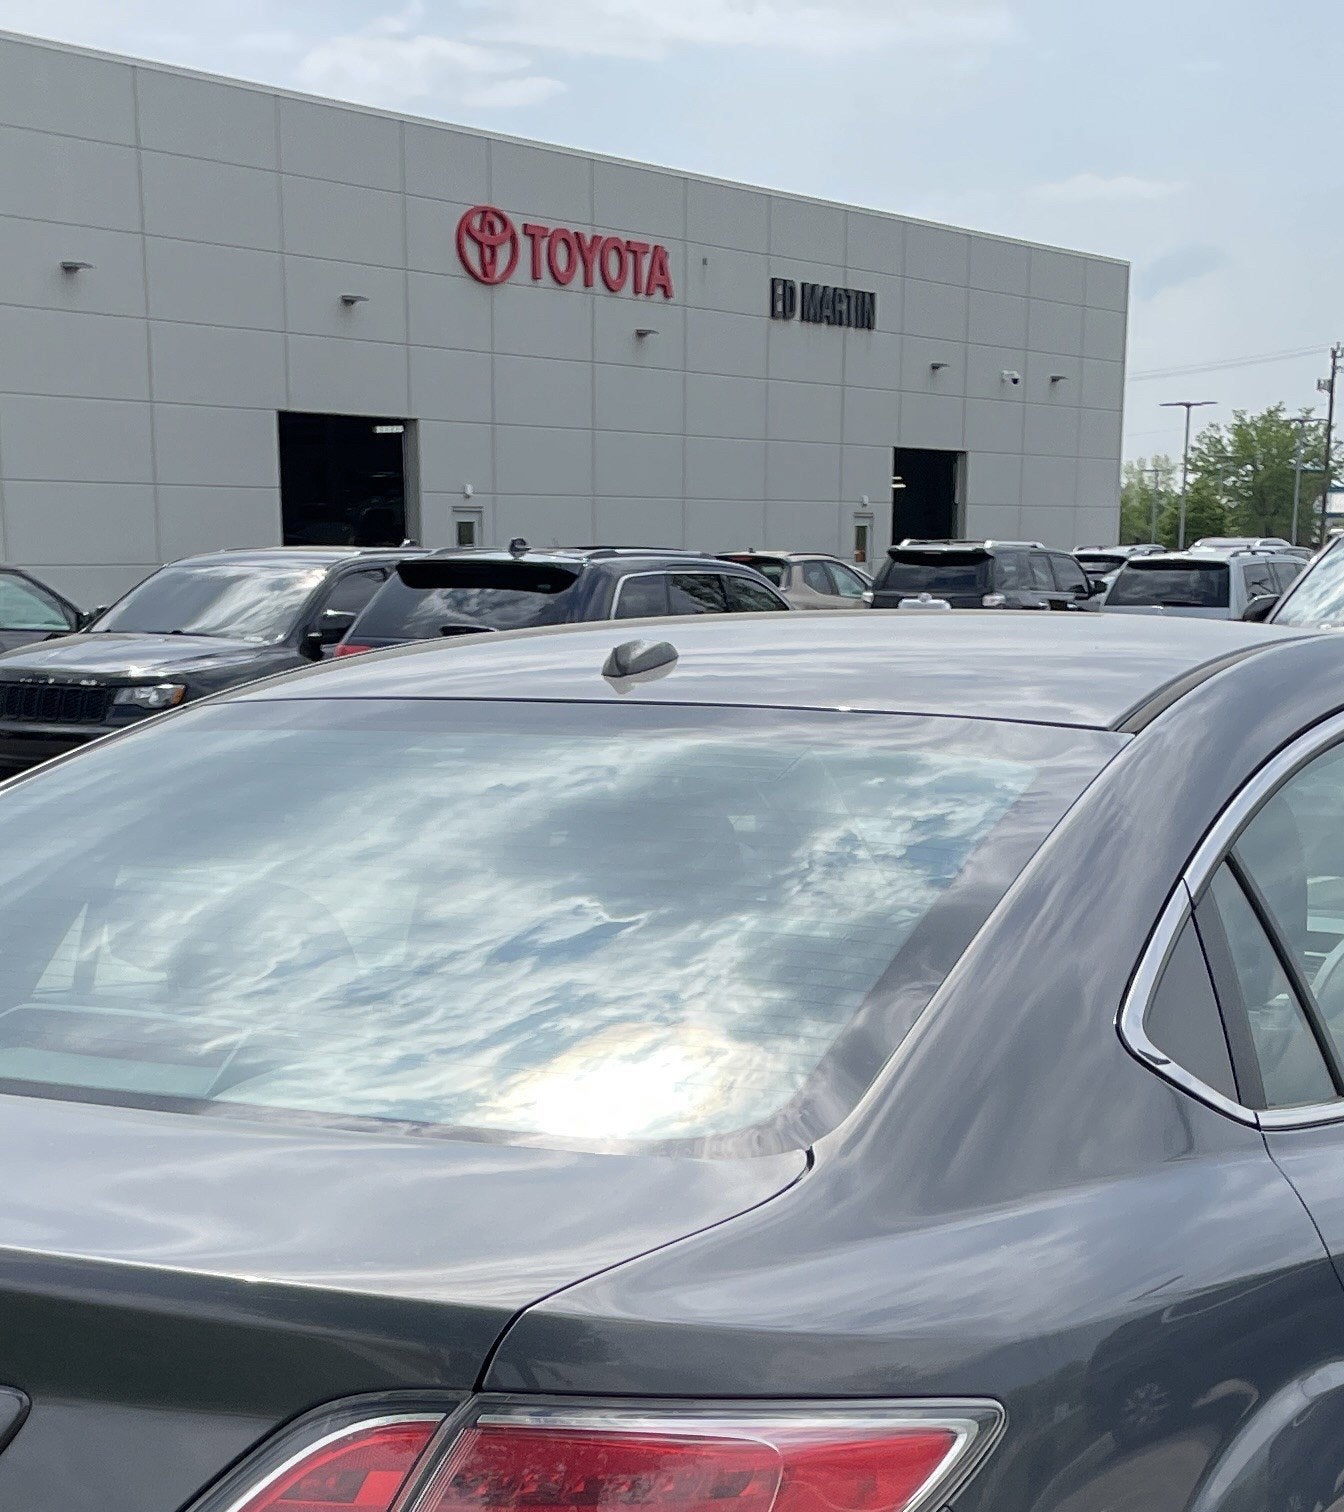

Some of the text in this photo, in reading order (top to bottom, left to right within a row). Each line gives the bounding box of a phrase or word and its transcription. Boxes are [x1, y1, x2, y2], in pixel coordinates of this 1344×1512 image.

[522, 223, 673, 299] TOYOTA
[771, 277, 876, 329] ED MARTIN
